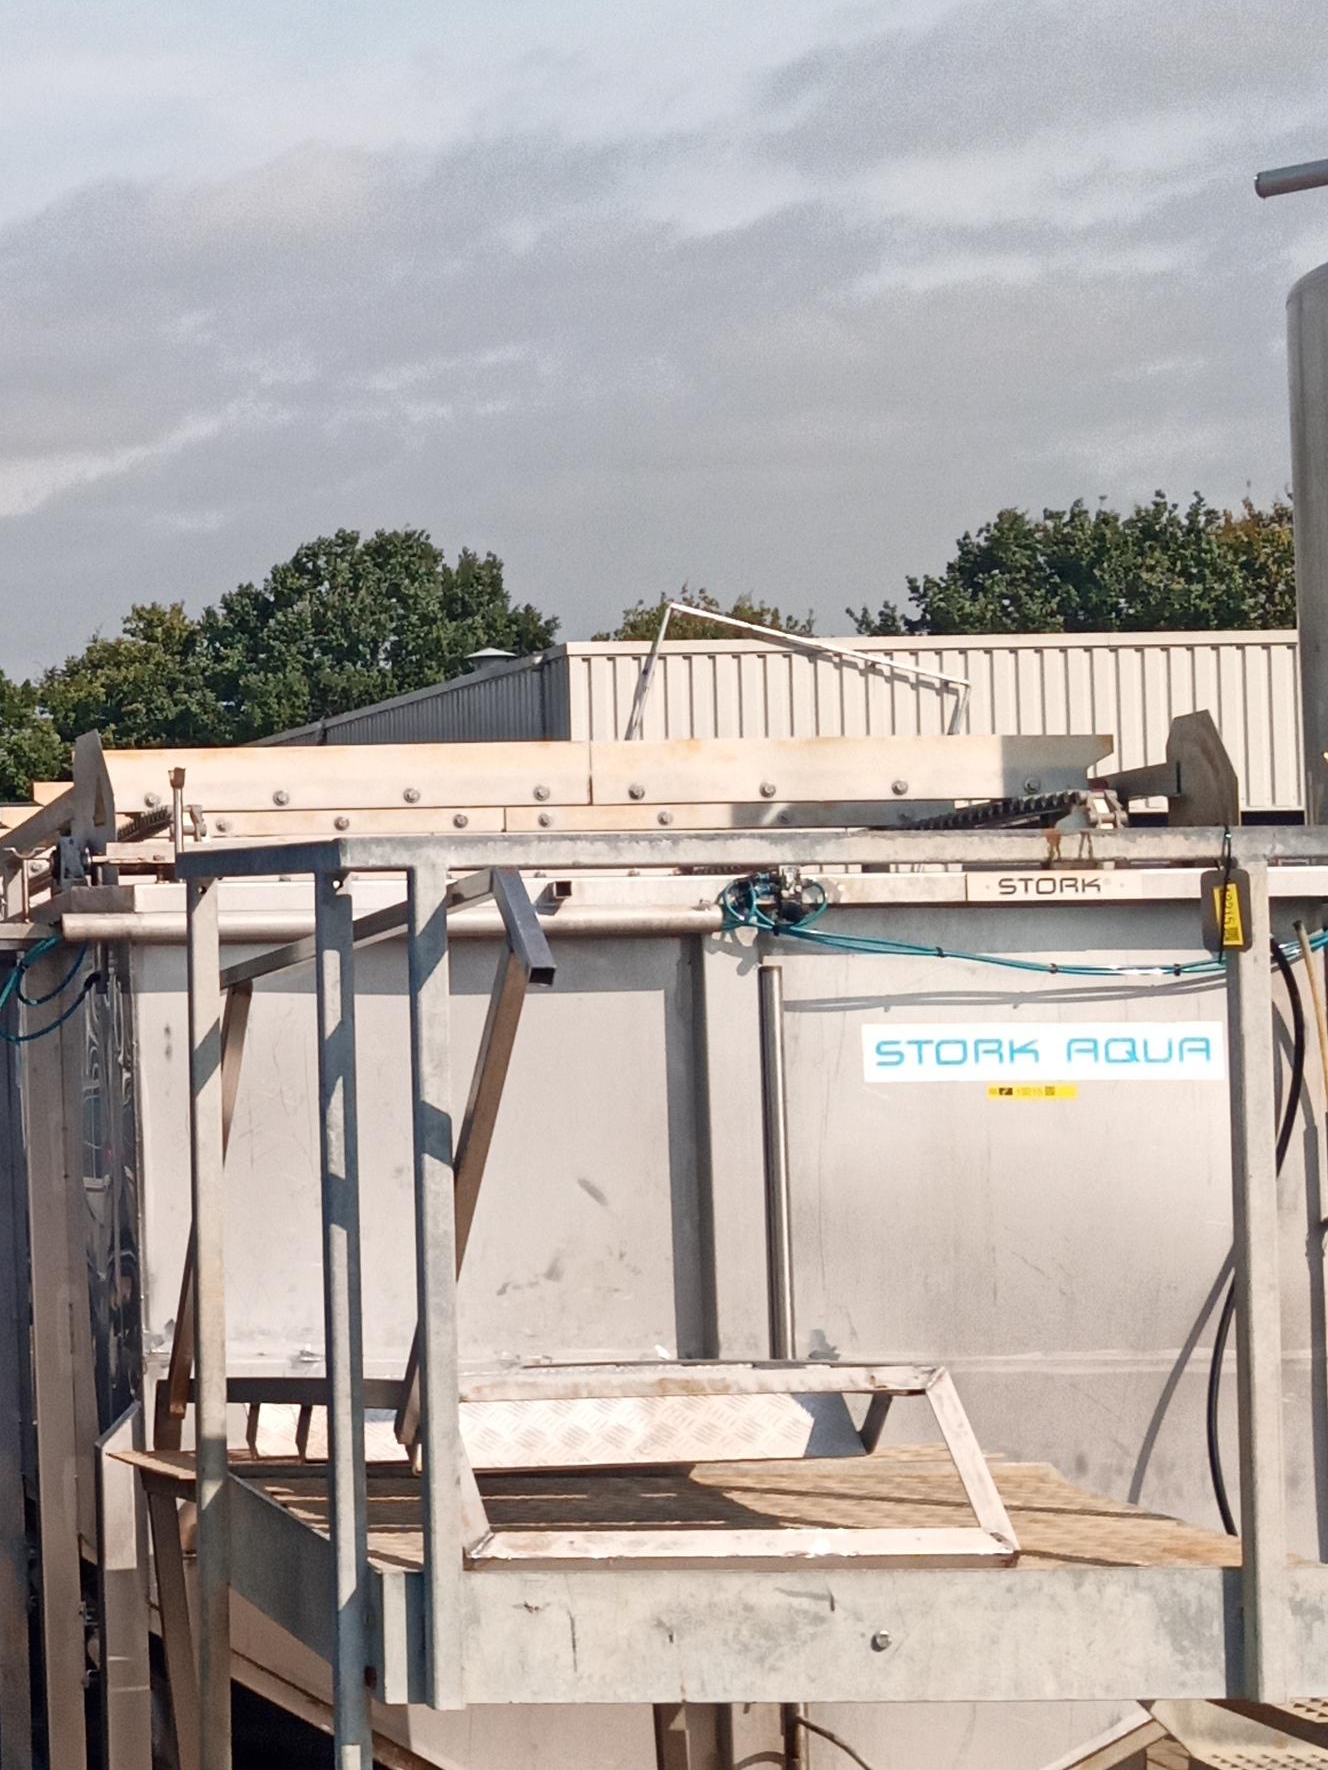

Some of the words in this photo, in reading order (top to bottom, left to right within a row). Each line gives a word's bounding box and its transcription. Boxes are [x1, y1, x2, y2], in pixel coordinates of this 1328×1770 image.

[998, 877, 1101, 895] STORK
[875, 1038, 1040, 1066] STORK
[1066, 1037, 1211, 1063] AQUA
